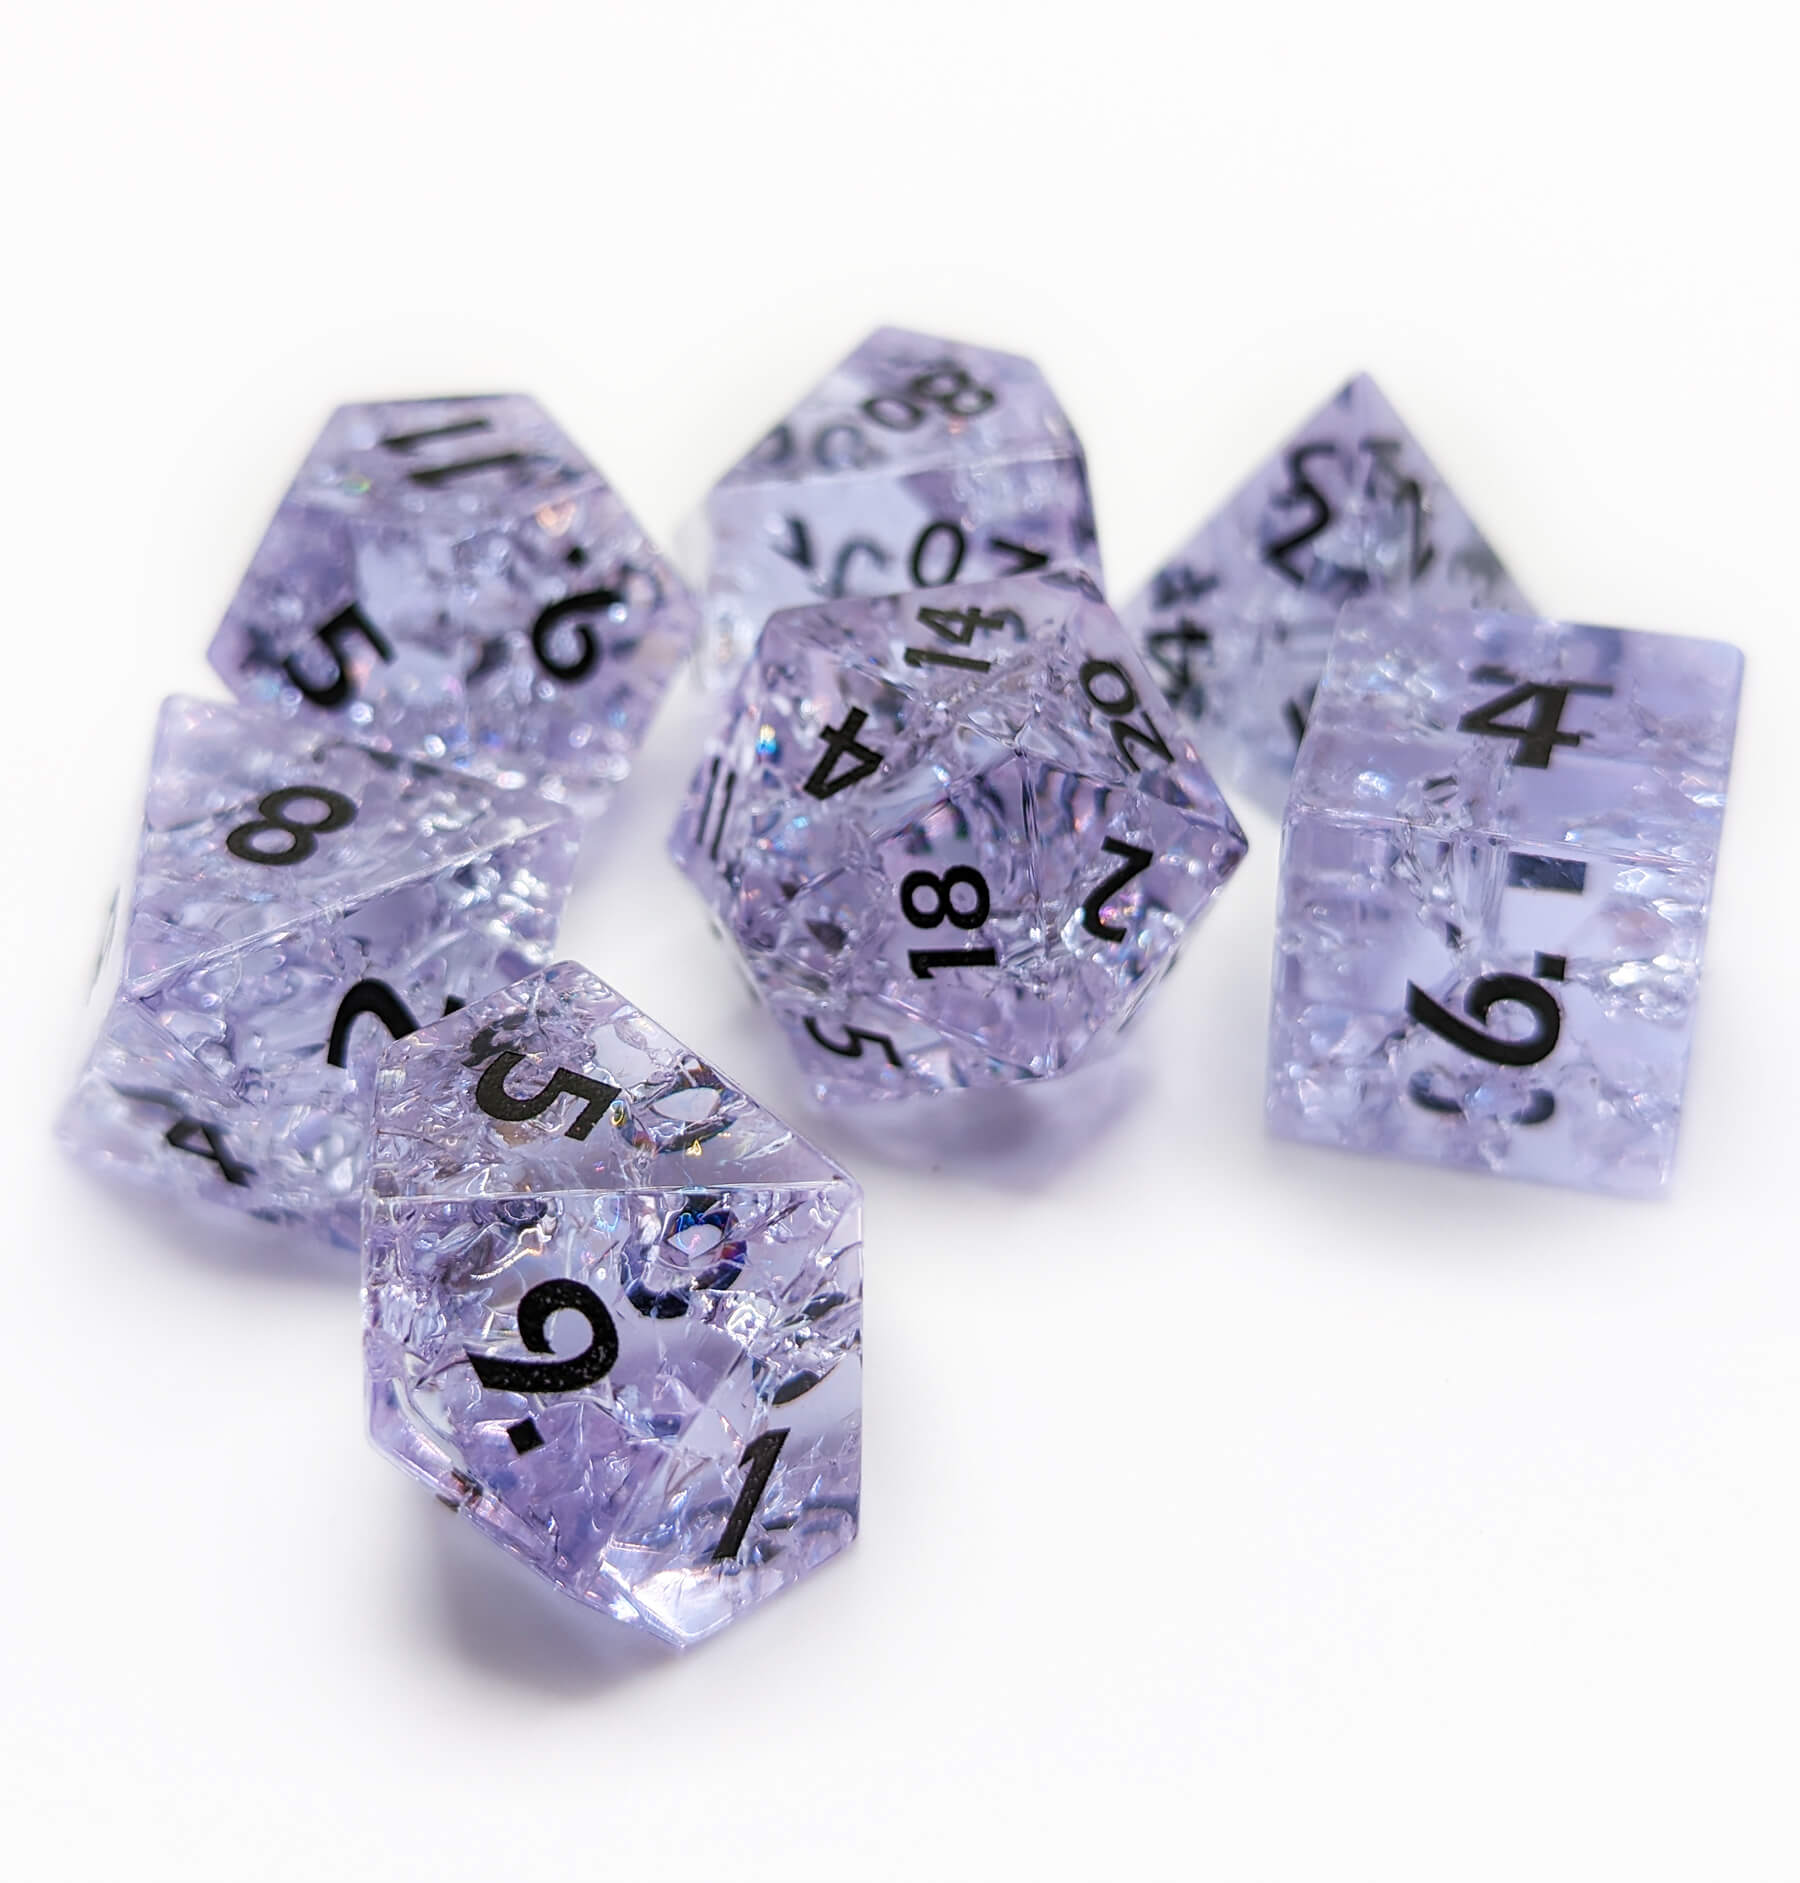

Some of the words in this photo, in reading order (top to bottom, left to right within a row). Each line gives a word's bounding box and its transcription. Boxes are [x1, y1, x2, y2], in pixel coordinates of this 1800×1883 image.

[378, 417, 529, 489] 11
[281, 601, 396, 707] 5
[903, 606, 1004, 675] 14
[802, 706, 885, 801] 4
[1078, 656, 1176, 774] 20
[1456, 680, 1583, 769] 4
[225, 785, 358, 867] 8
[900, 865, 999, 981] 18
[1082, 836, 1154, 943] 2
[804, 1016, 903, 1069] 5
[475, 1050, 622, 1142] 5
[710, 1427, 791, 1562] 1
